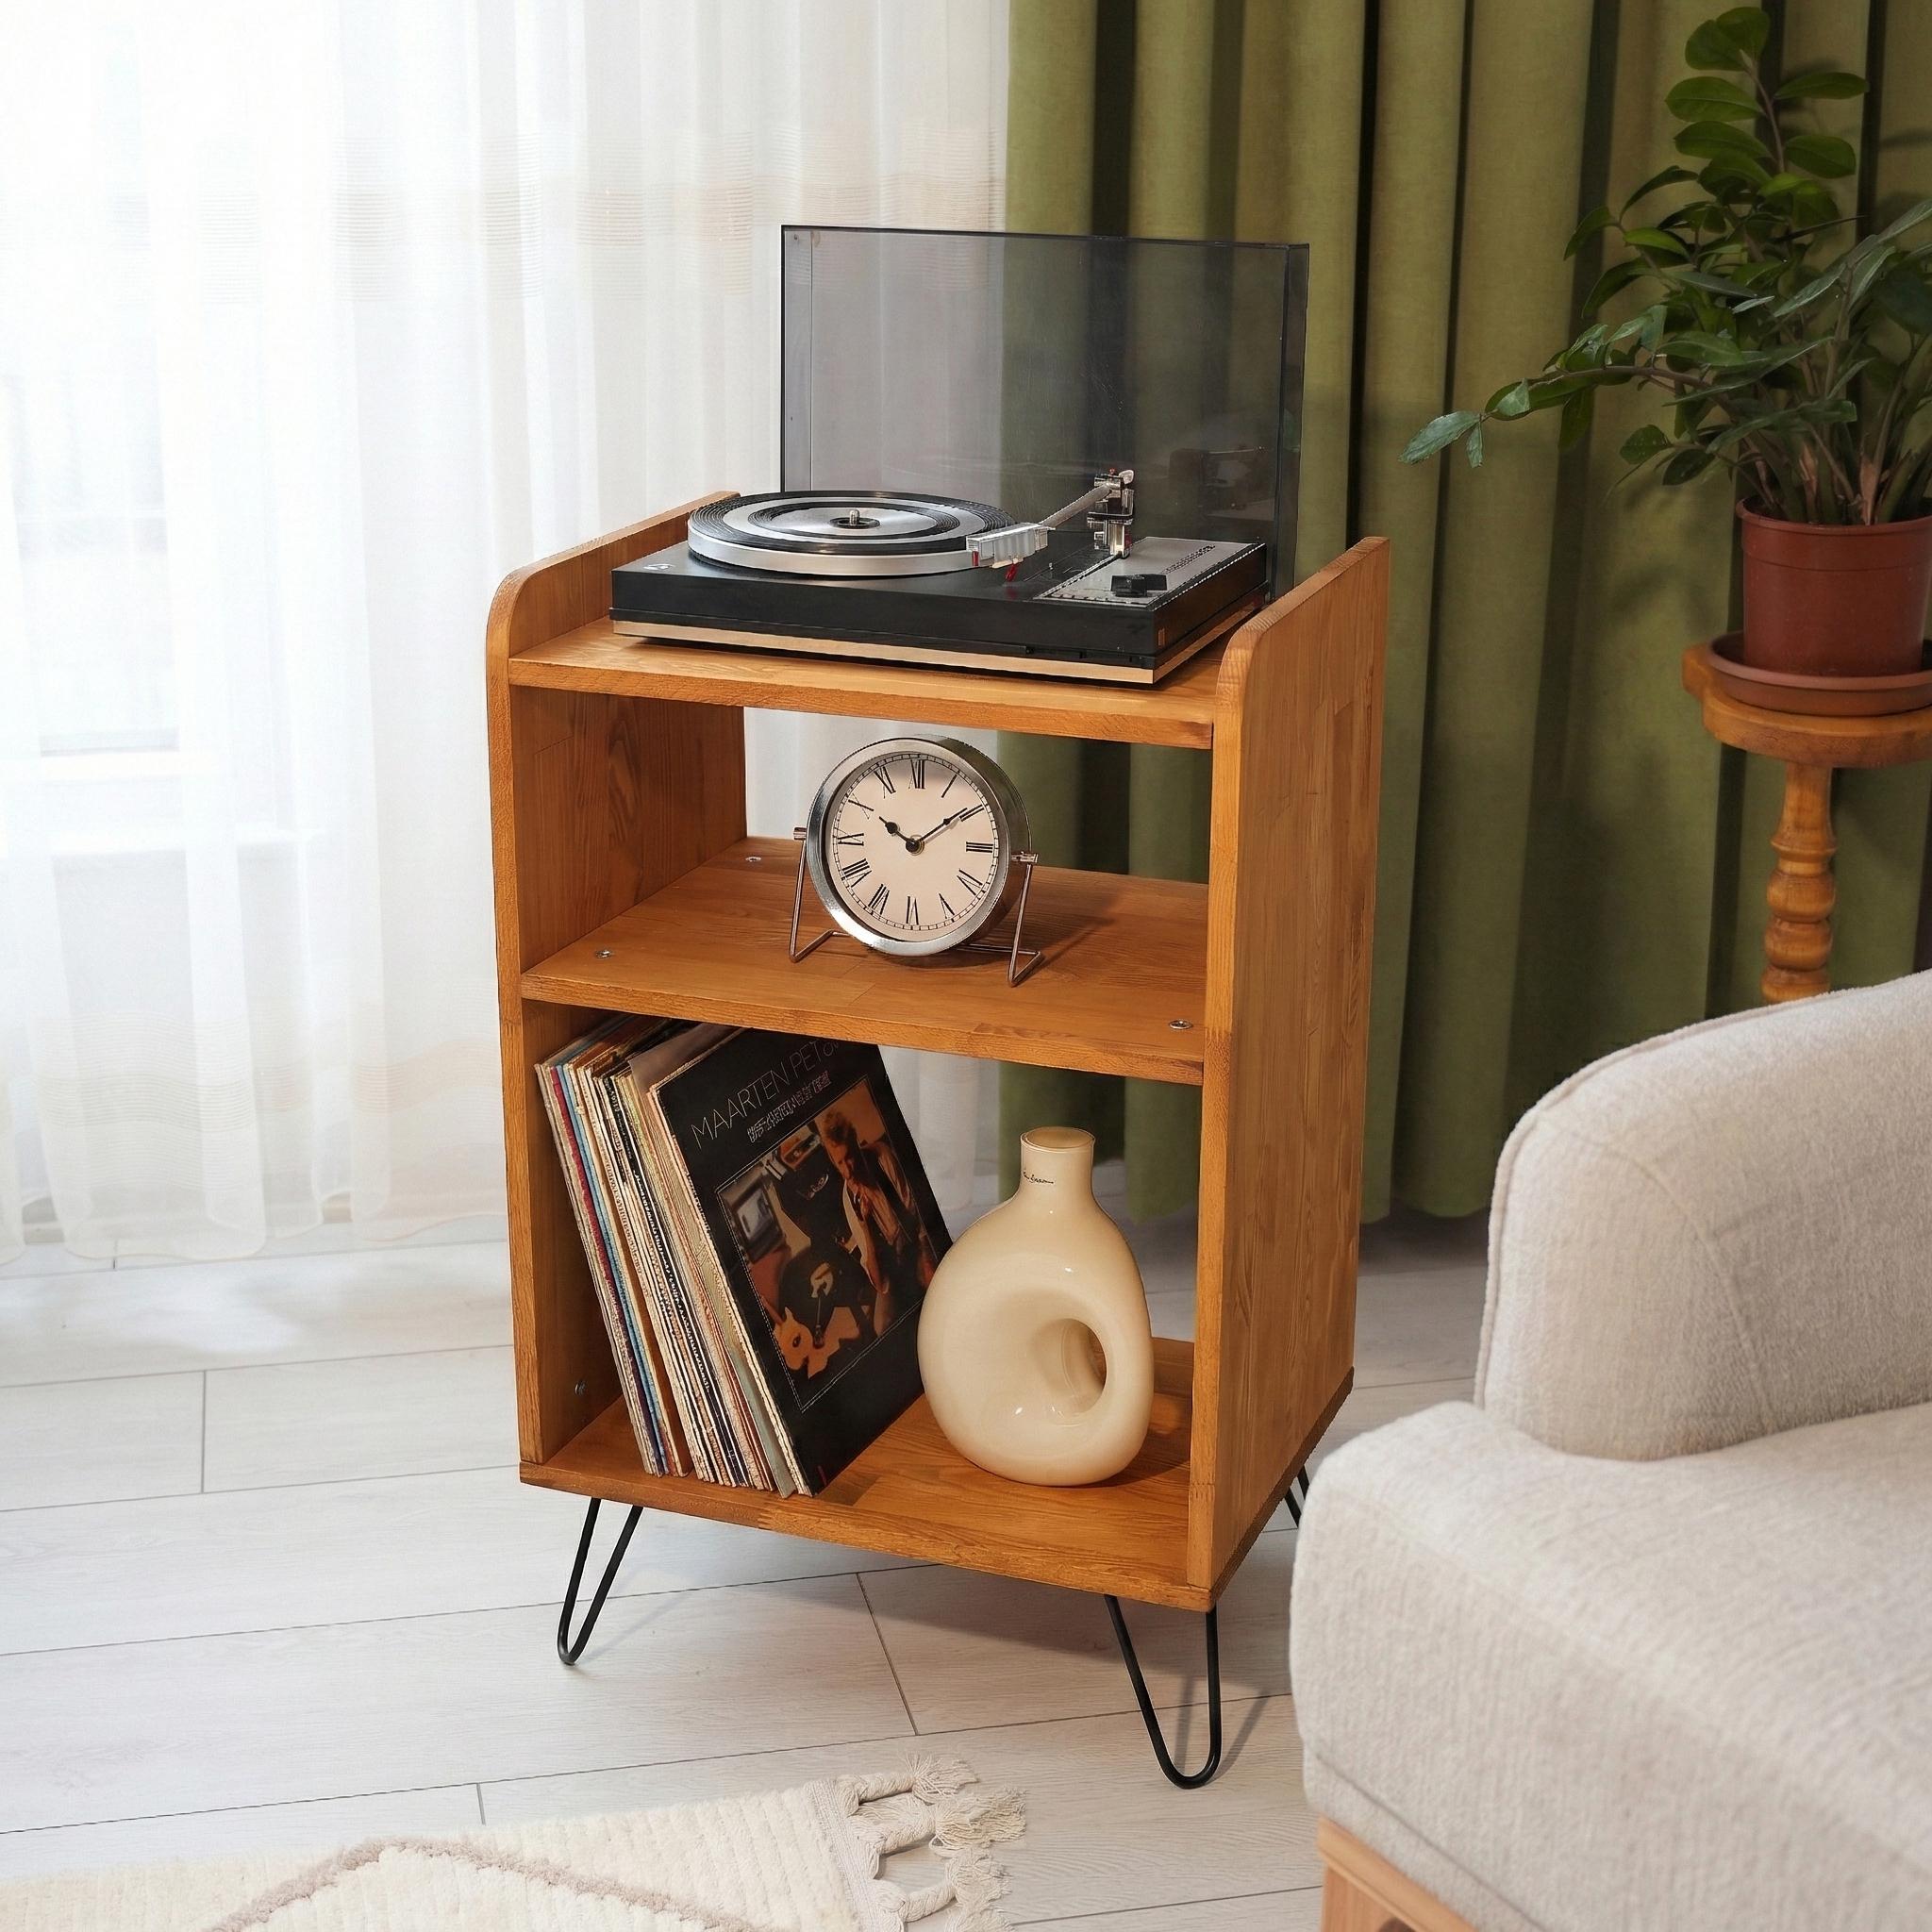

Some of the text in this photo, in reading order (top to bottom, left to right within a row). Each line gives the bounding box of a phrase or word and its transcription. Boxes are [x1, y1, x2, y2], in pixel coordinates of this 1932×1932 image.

[874, 765, 896, 799] XI
[908, 758, 925, 790] XII
[941, 774, 958, 798] I
[848, 792, 874, 820] X
[837, 828, 864, 846] IX
[965, 841, 994, 854] III
[841, 858, 872, 888] VIII
[956, 868, 983, 897] IV
[868, 883, 890, 916] VII
[906, 895, 920, 925] VI
[939, 893, 956, 920] V
[691, 1061, 790, 1149] MAARTEN
